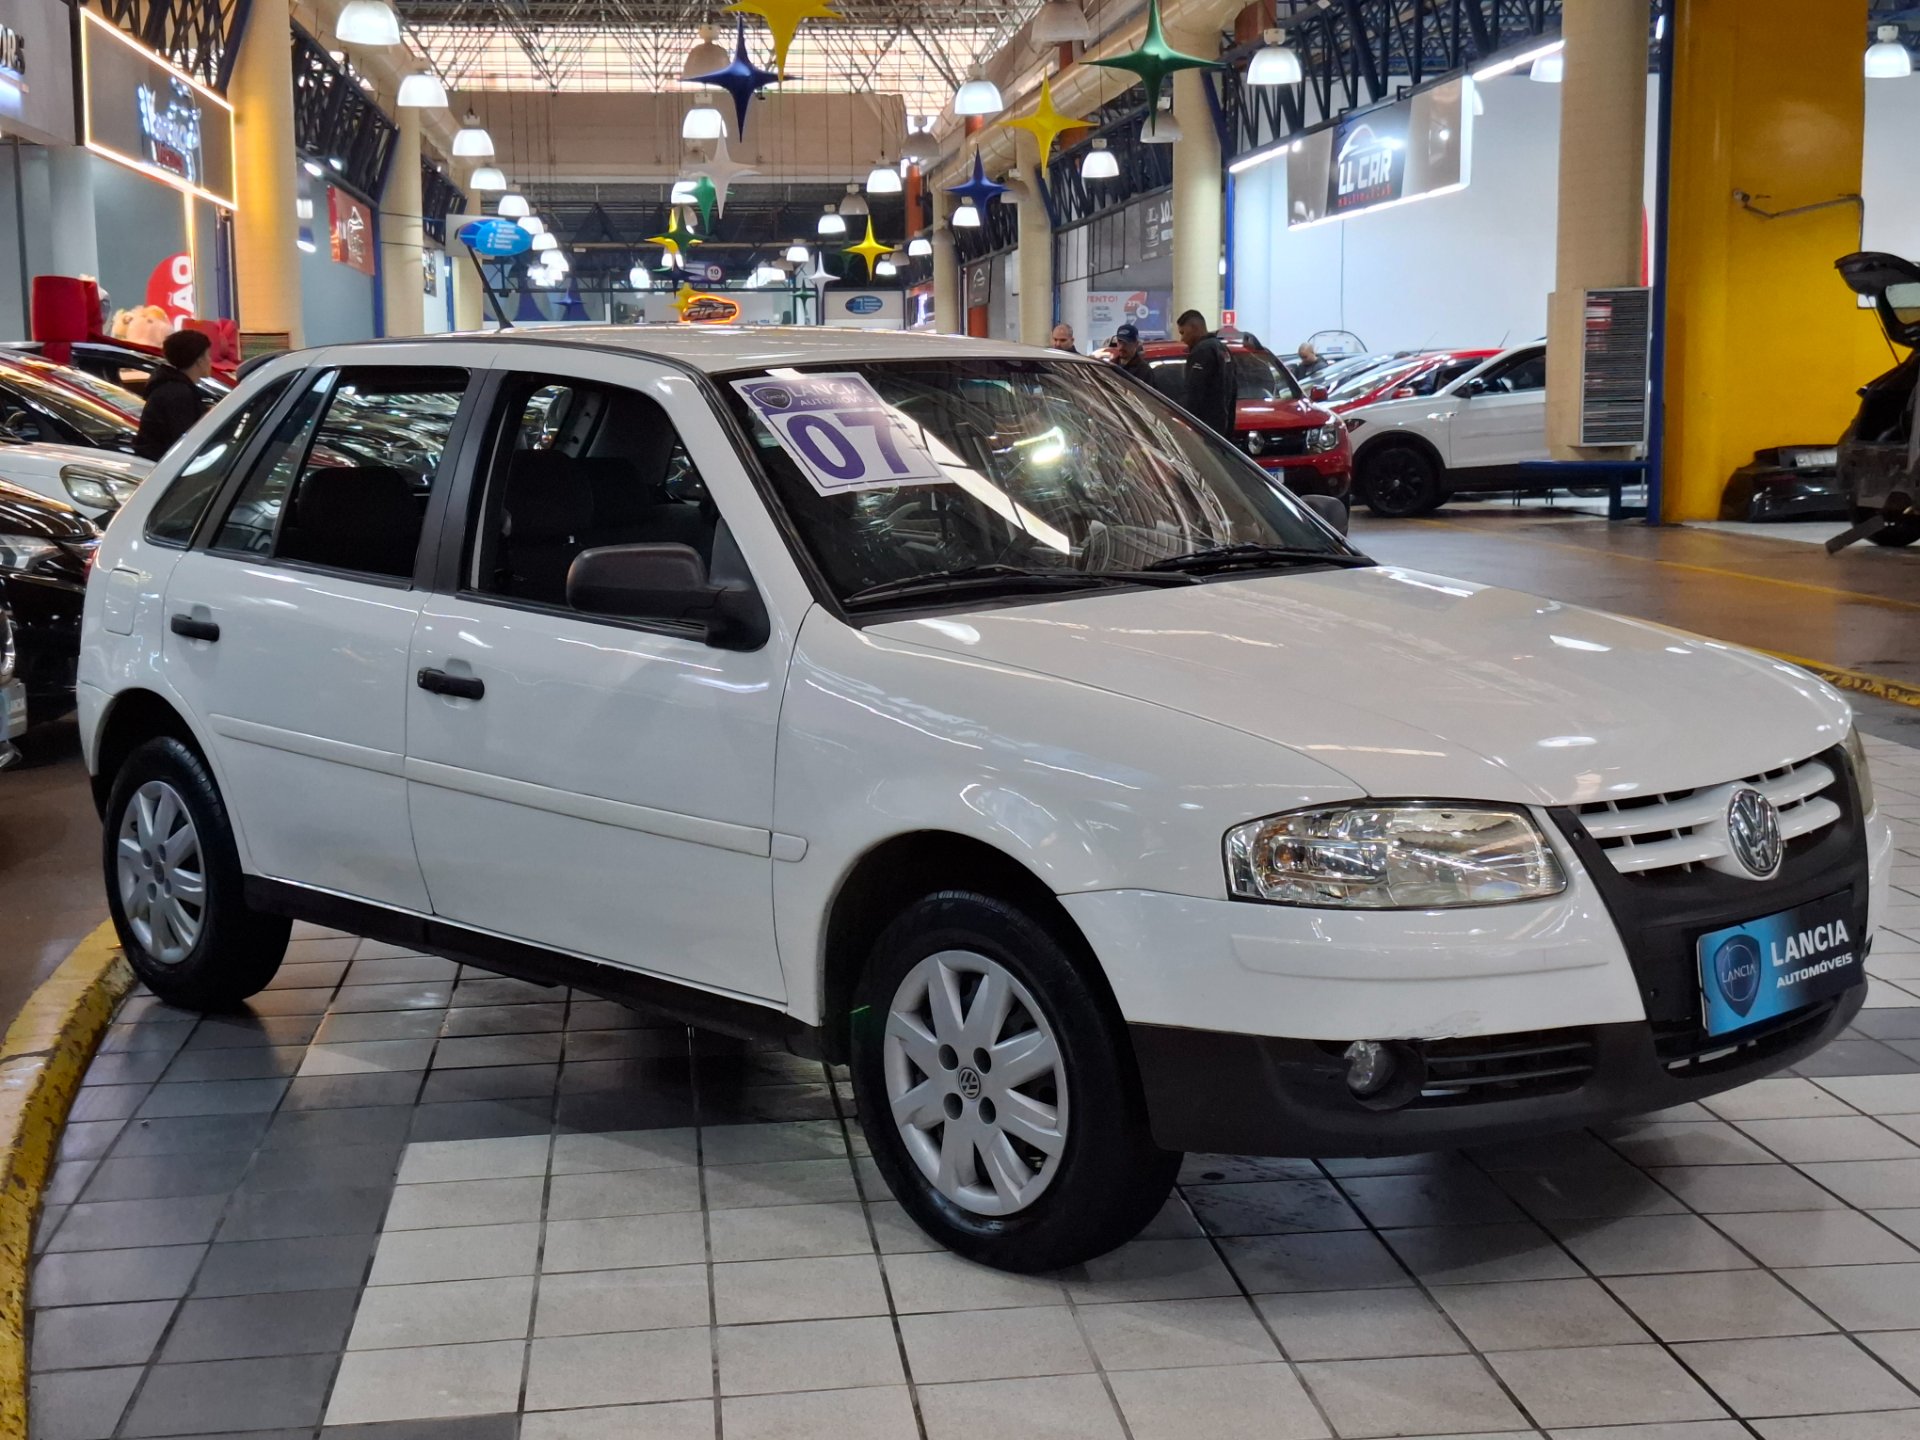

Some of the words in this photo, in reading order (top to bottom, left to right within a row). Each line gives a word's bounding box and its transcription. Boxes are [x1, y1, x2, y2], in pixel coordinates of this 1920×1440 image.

[1338, 161, 1355, 196] LL
[1358, 149, 1392, 189] CAR
[1087, 295, 1118, 303] ENTO!
[786, 382, 867, 397] LANCIA
[787, 411, 910, 479] 07
[1771, 919, 1849, 967] LANCIA
[1721, 964, 1757, 983] LANCIA
[1776, 952, 1853, 988] AUTOMÓVEIS
